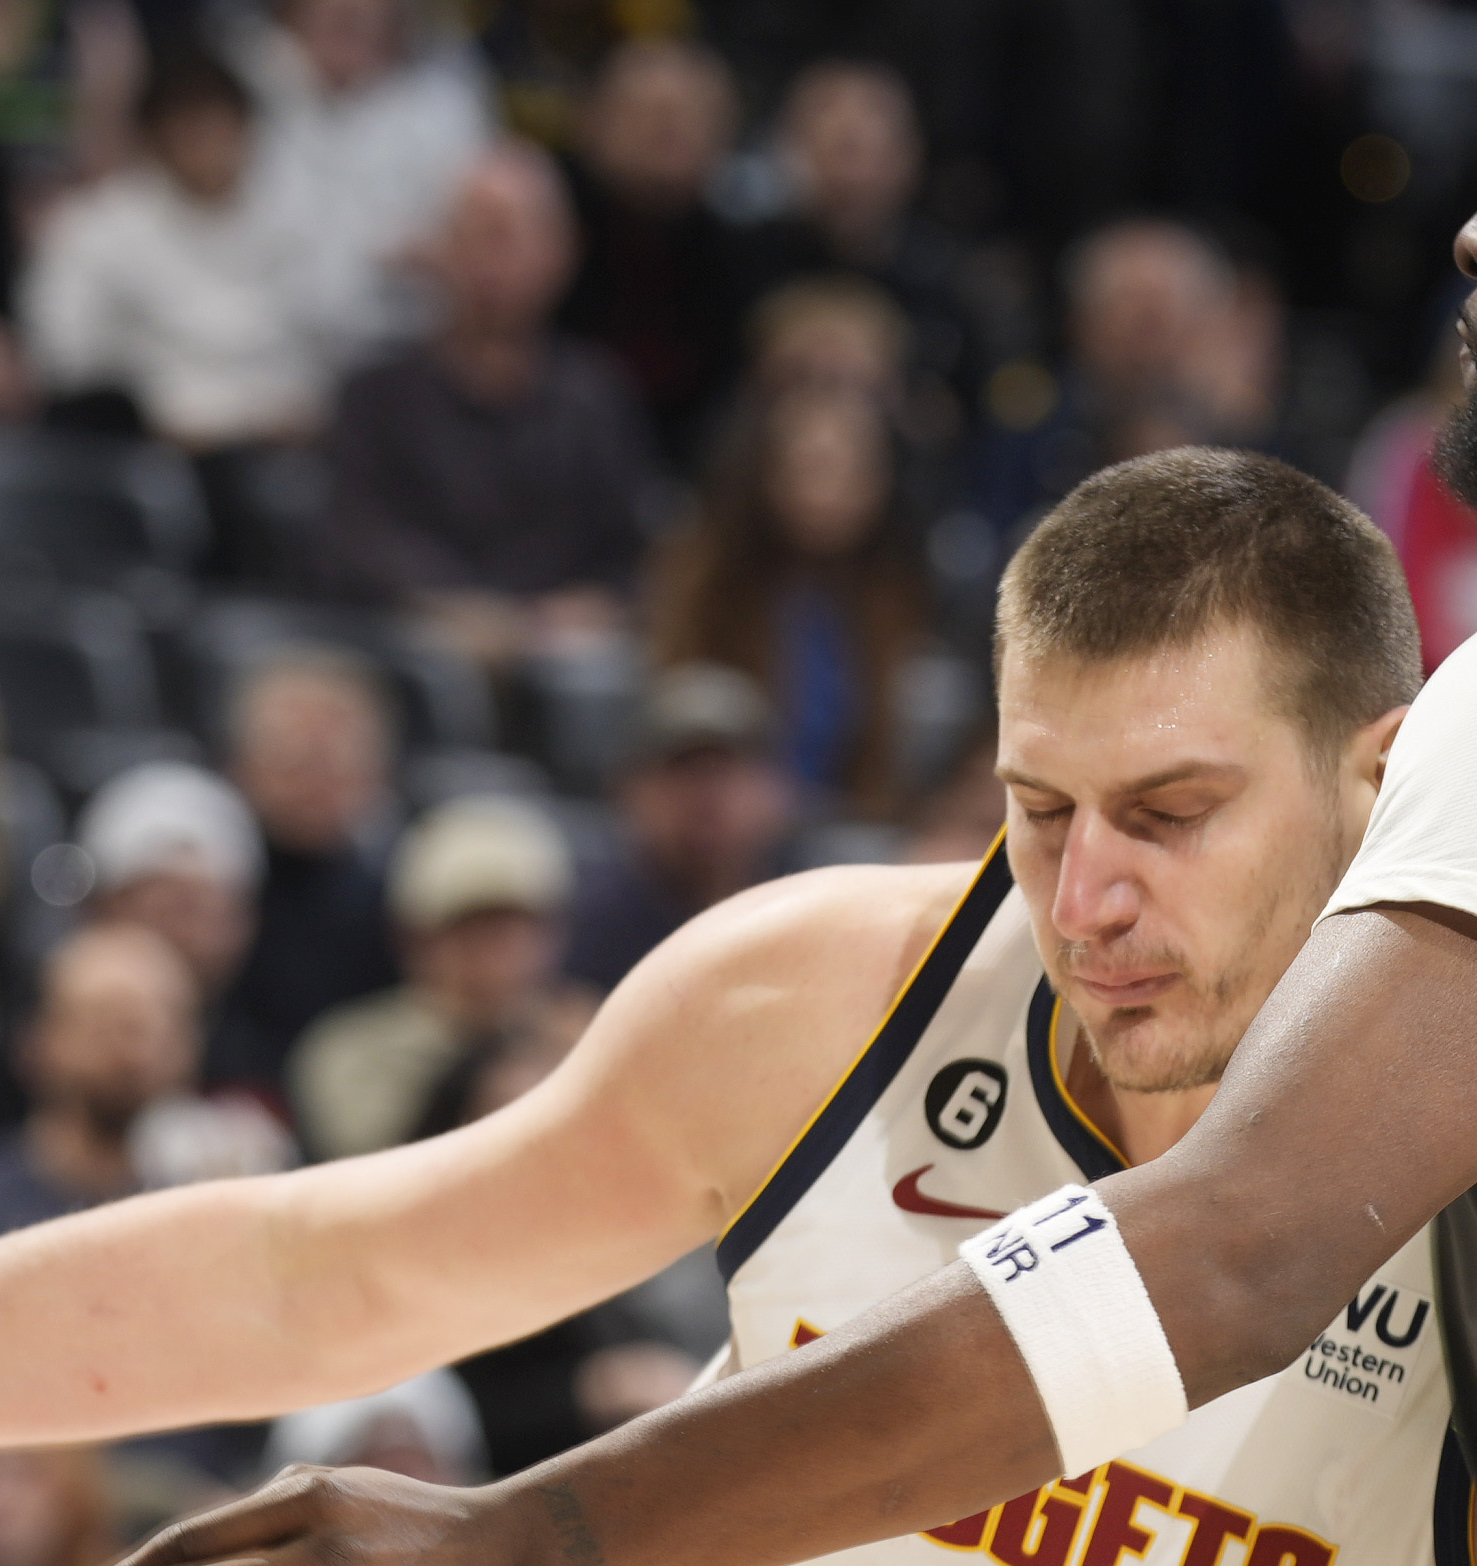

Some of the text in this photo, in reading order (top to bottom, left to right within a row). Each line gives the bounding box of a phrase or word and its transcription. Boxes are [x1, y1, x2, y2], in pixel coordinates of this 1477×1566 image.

[937, 1069, 1002, 1143] 6
[1033, 1195, 1107, 1253] 11
[981, 1227, 1039, 1283] NR
[1304, 1355, 1380, 1403] Union
